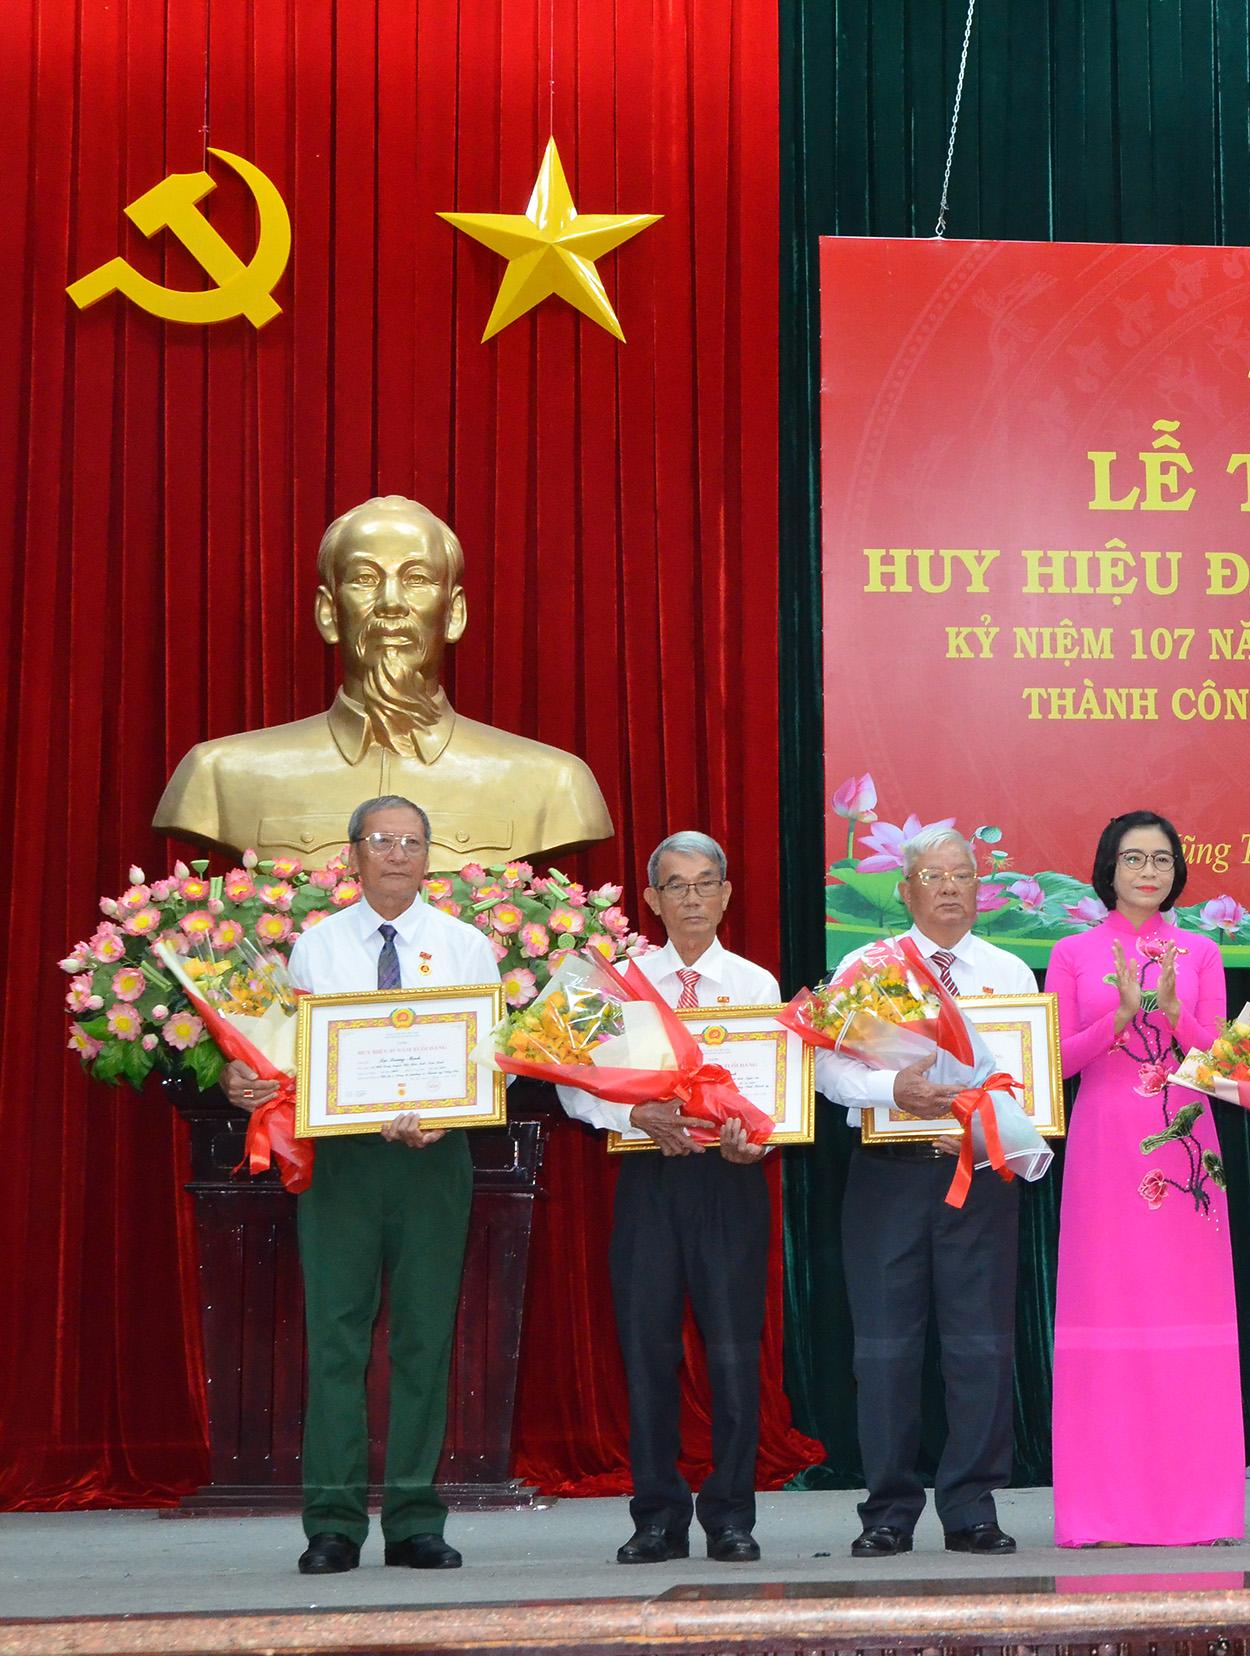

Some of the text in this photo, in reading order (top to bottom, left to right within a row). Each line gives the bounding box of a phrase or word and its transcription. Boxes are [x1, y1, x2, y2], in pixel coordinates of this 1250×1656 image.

[1087, 418, 1197, 512] LỄ
[863, 547, 1000, 594] HUY
[1023, 539, 1182, 605] HIỆU
[946, 614, 1000, 659] KỶ
[1014, 619, 1113, 668] NIỆM
[1132, 627, 1195, 661] 107
[1023, 679, 1159, 721] THÀNH
[1181, 834, 1232, 873] ũng
